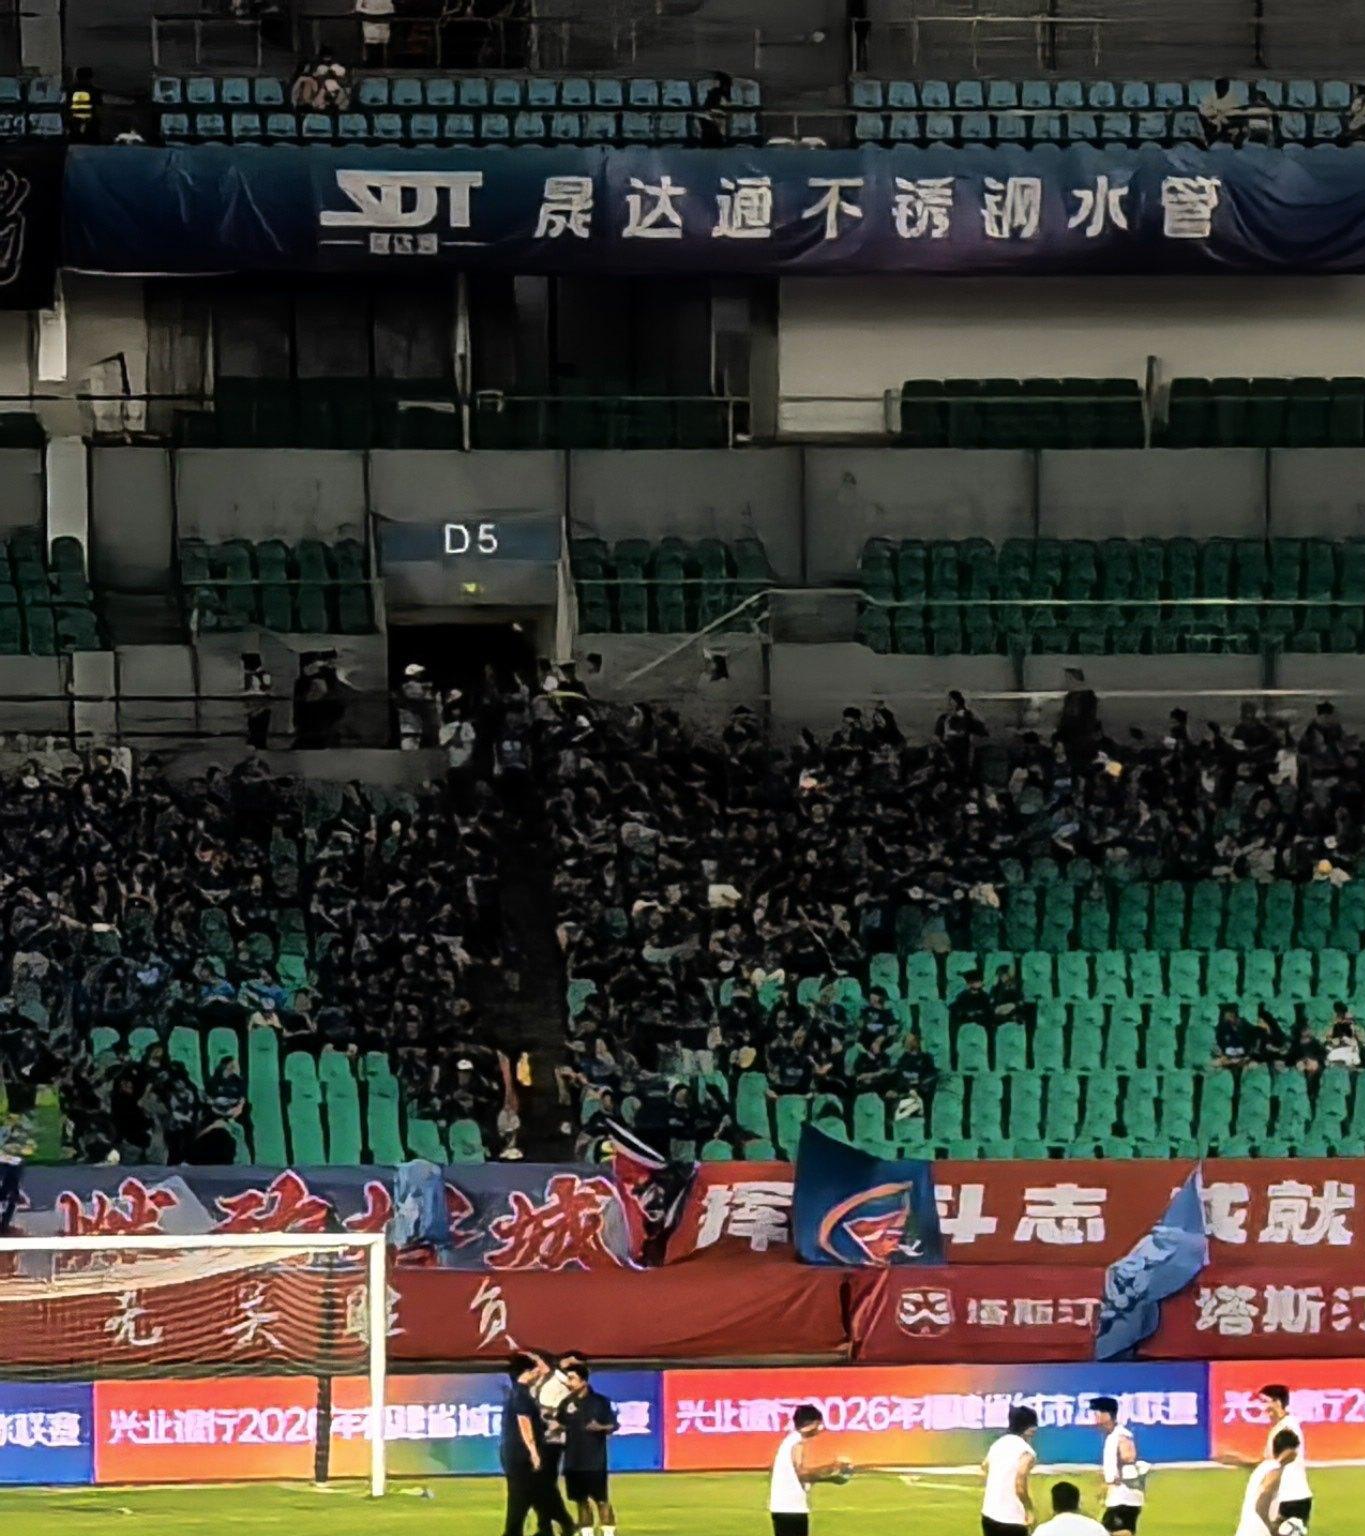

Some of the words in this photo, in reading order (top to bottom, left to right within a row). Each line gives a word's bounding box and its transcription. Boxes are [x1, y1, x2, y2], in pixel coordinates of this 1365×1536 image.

[444, 524, 499, 555] D5
[696, 1180, 1108, 1252] 挥斗志
